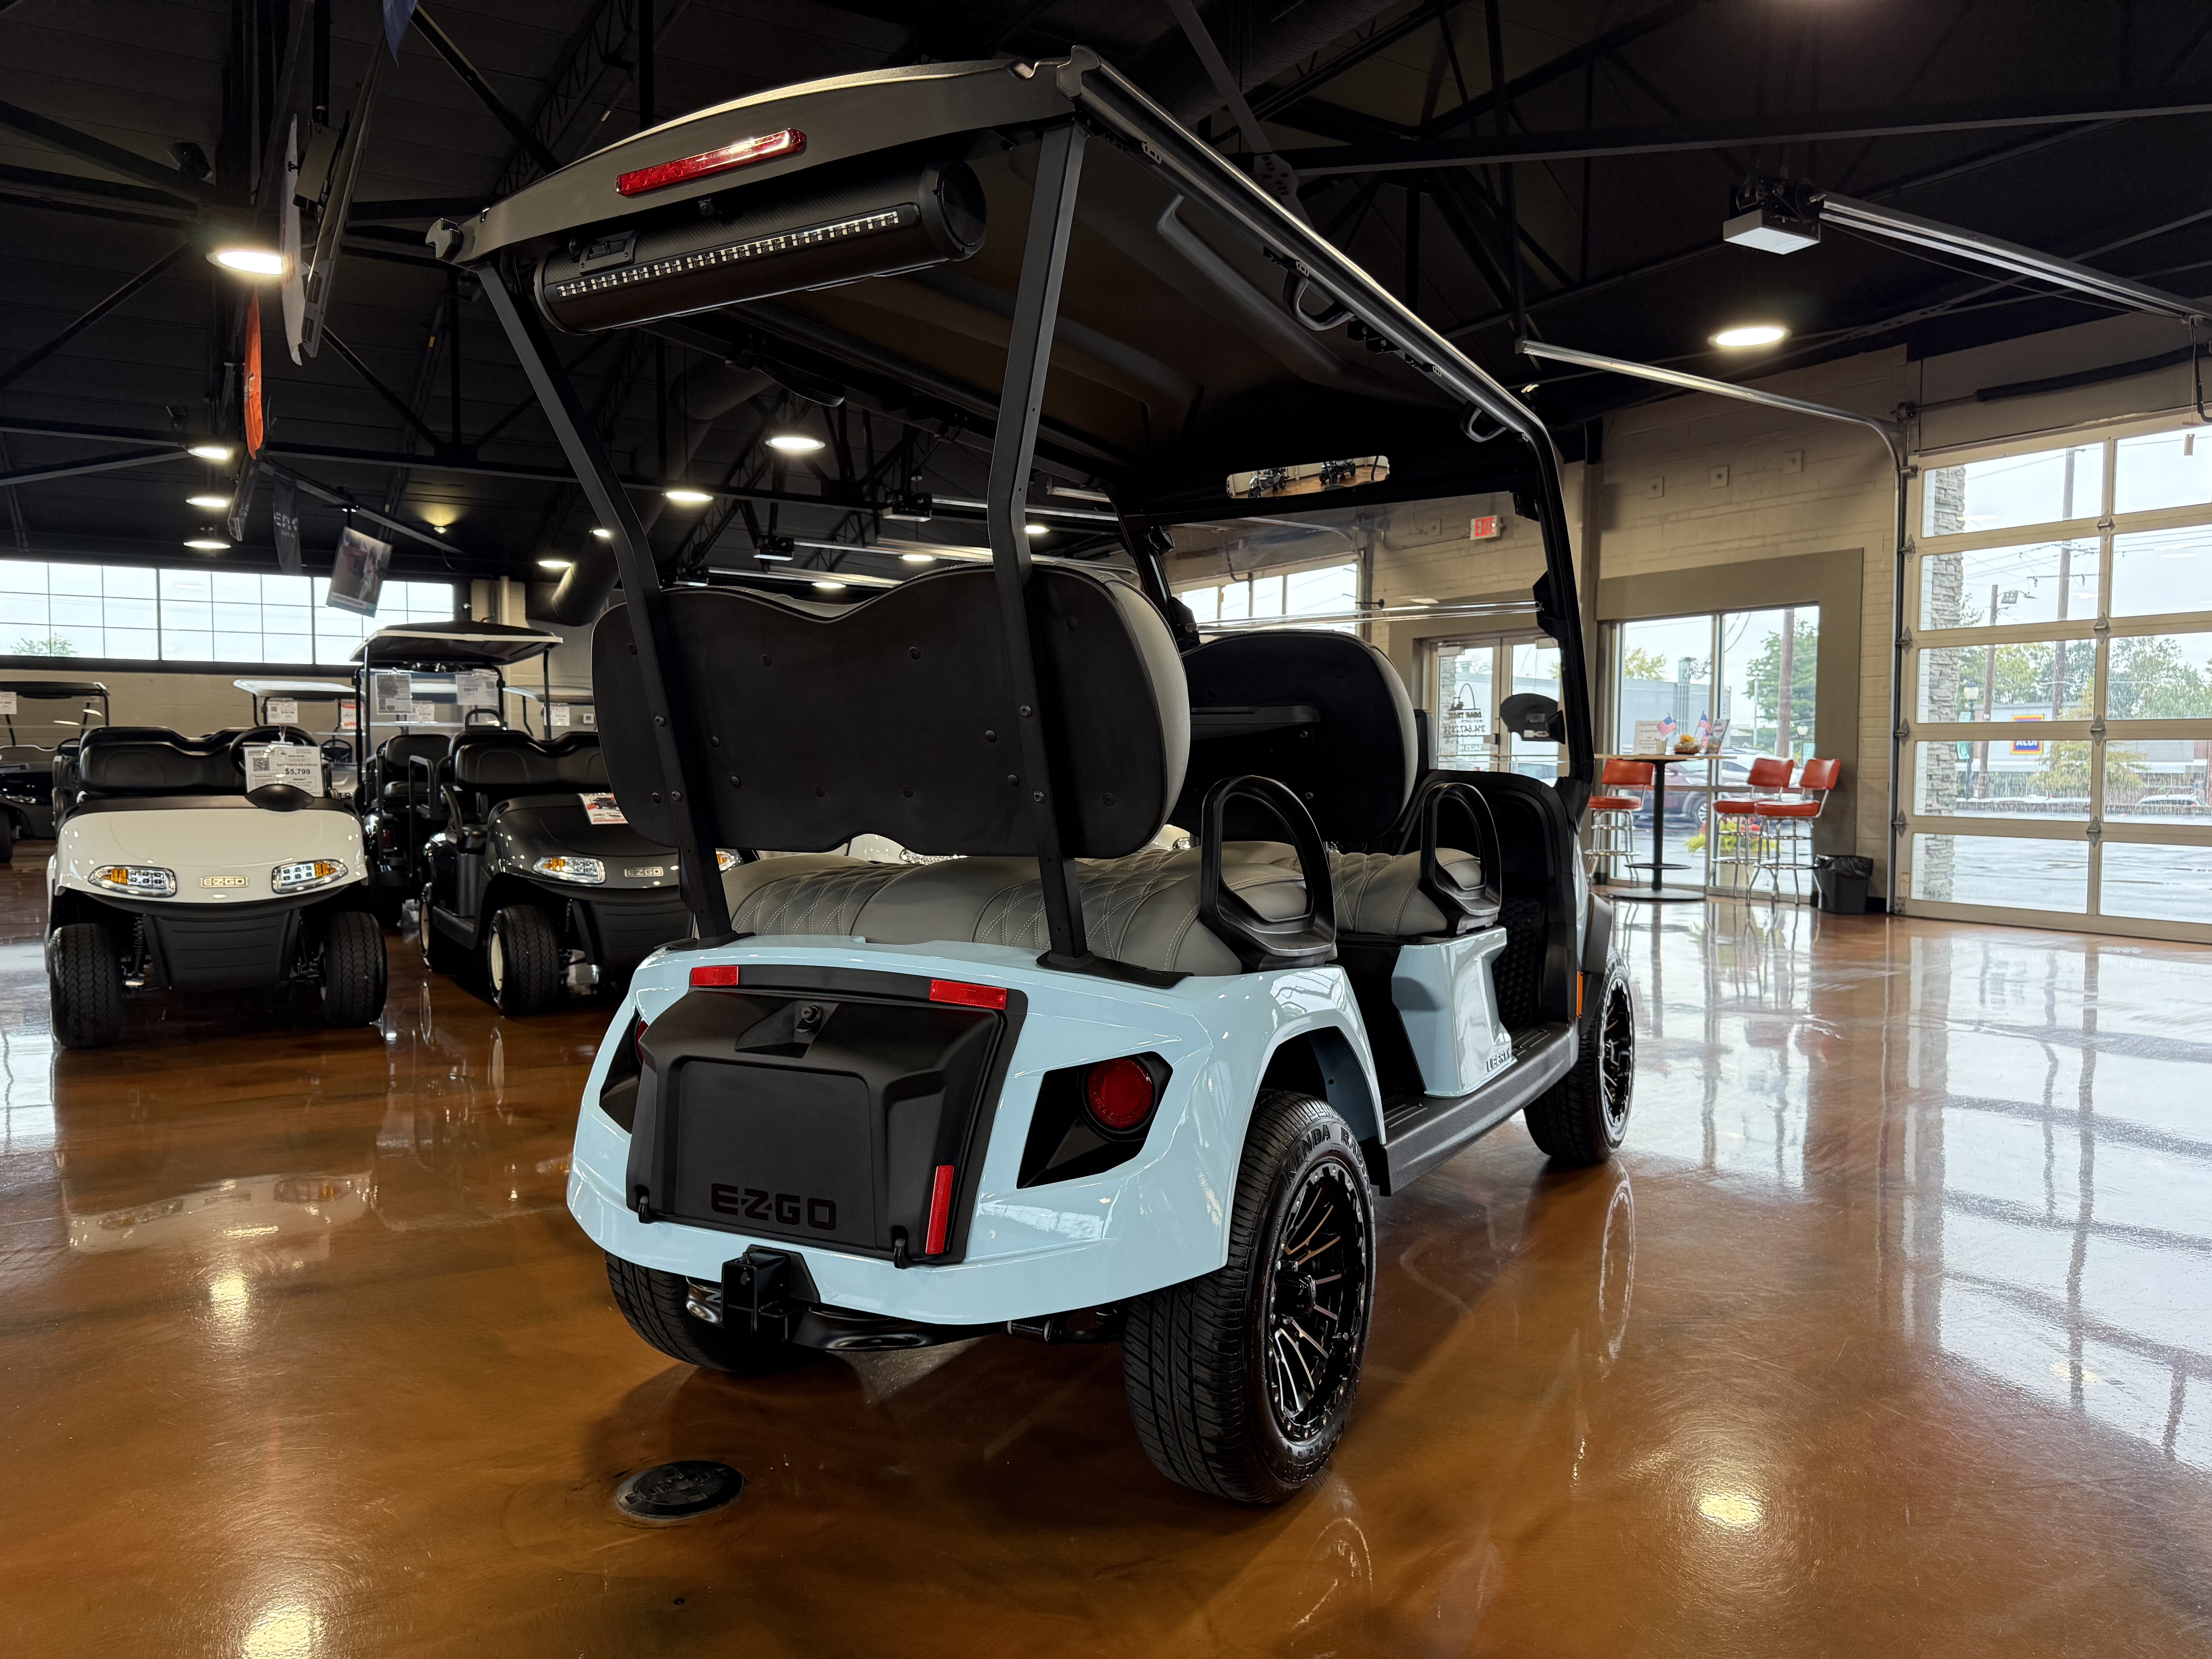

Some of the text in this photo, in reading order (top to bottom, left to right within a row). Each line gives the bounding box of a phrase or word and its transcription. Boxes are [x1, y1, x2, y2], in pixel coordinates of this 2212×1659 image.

[1475, 516, 1494, 537] EXIT
[203, 878, 246, 886] EZGO
[1486, 1046, 1510, 1072] LIBERTY
[1282, 1124, 1331, 1191] KENDA
[711, 1183, 836, 1231] EZGO
